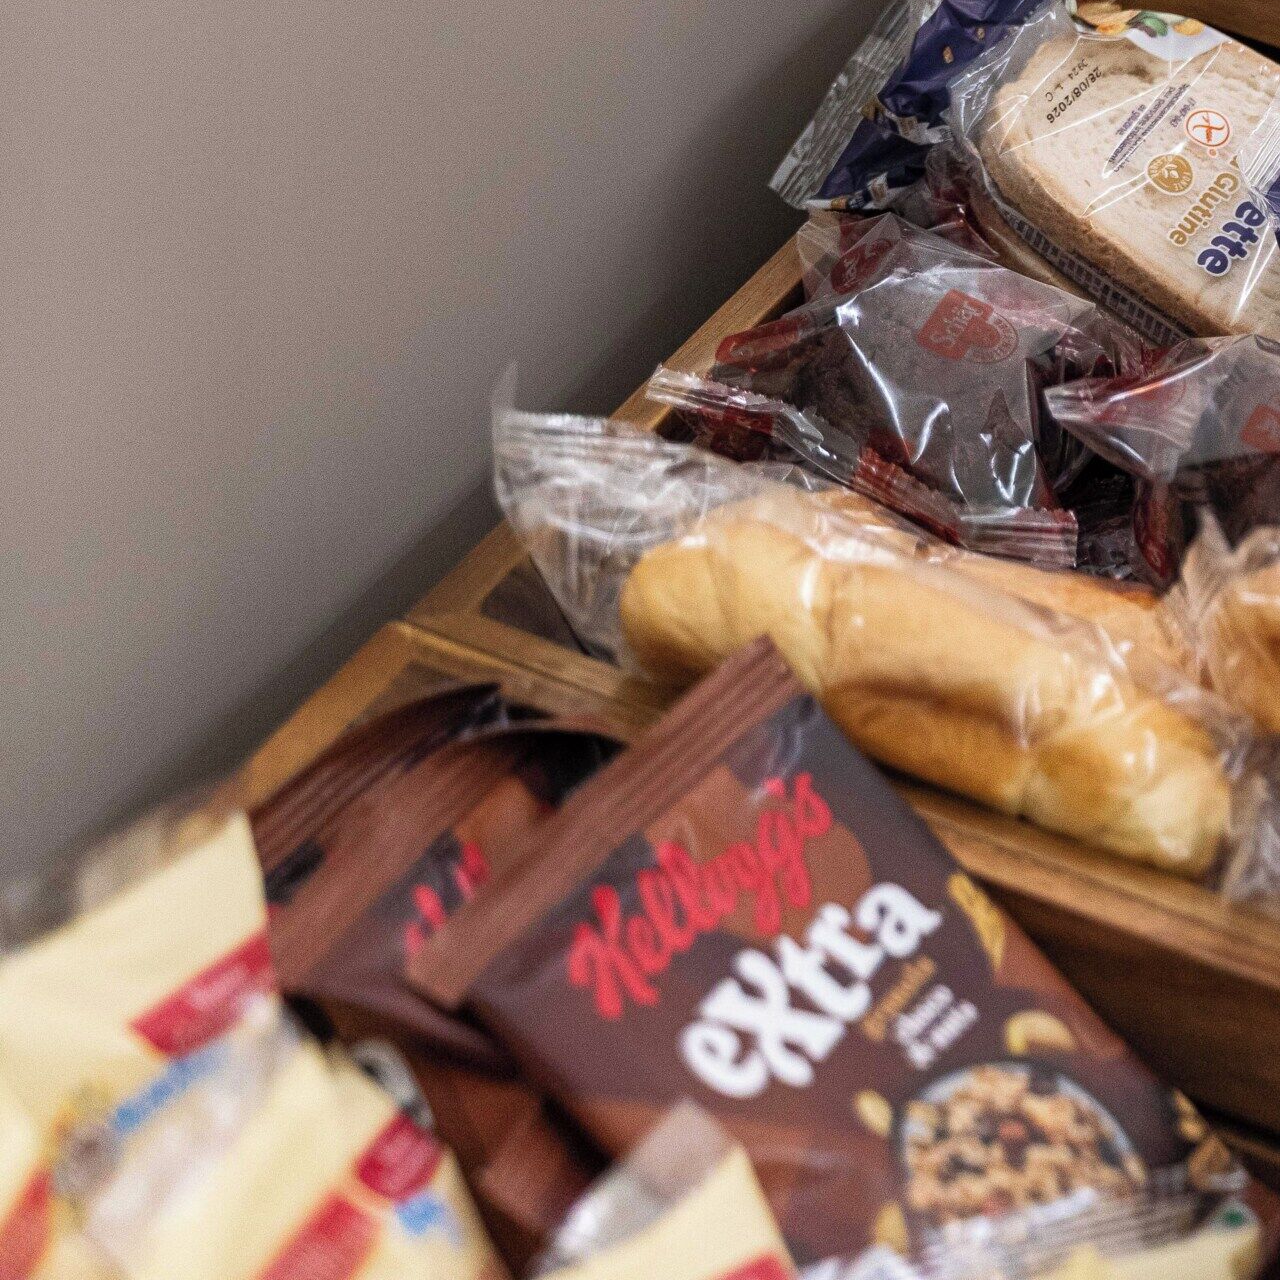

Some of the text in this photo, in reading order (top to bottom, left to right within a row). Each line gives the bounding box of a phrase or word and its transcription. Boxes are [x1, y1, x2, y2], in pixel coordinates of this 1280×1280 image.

[1046, 66, 1102, 124] 28/08/2026
[1169, 172, 1239, 246] Glutine
[568, 771, 833, 1021] Kellogg's
